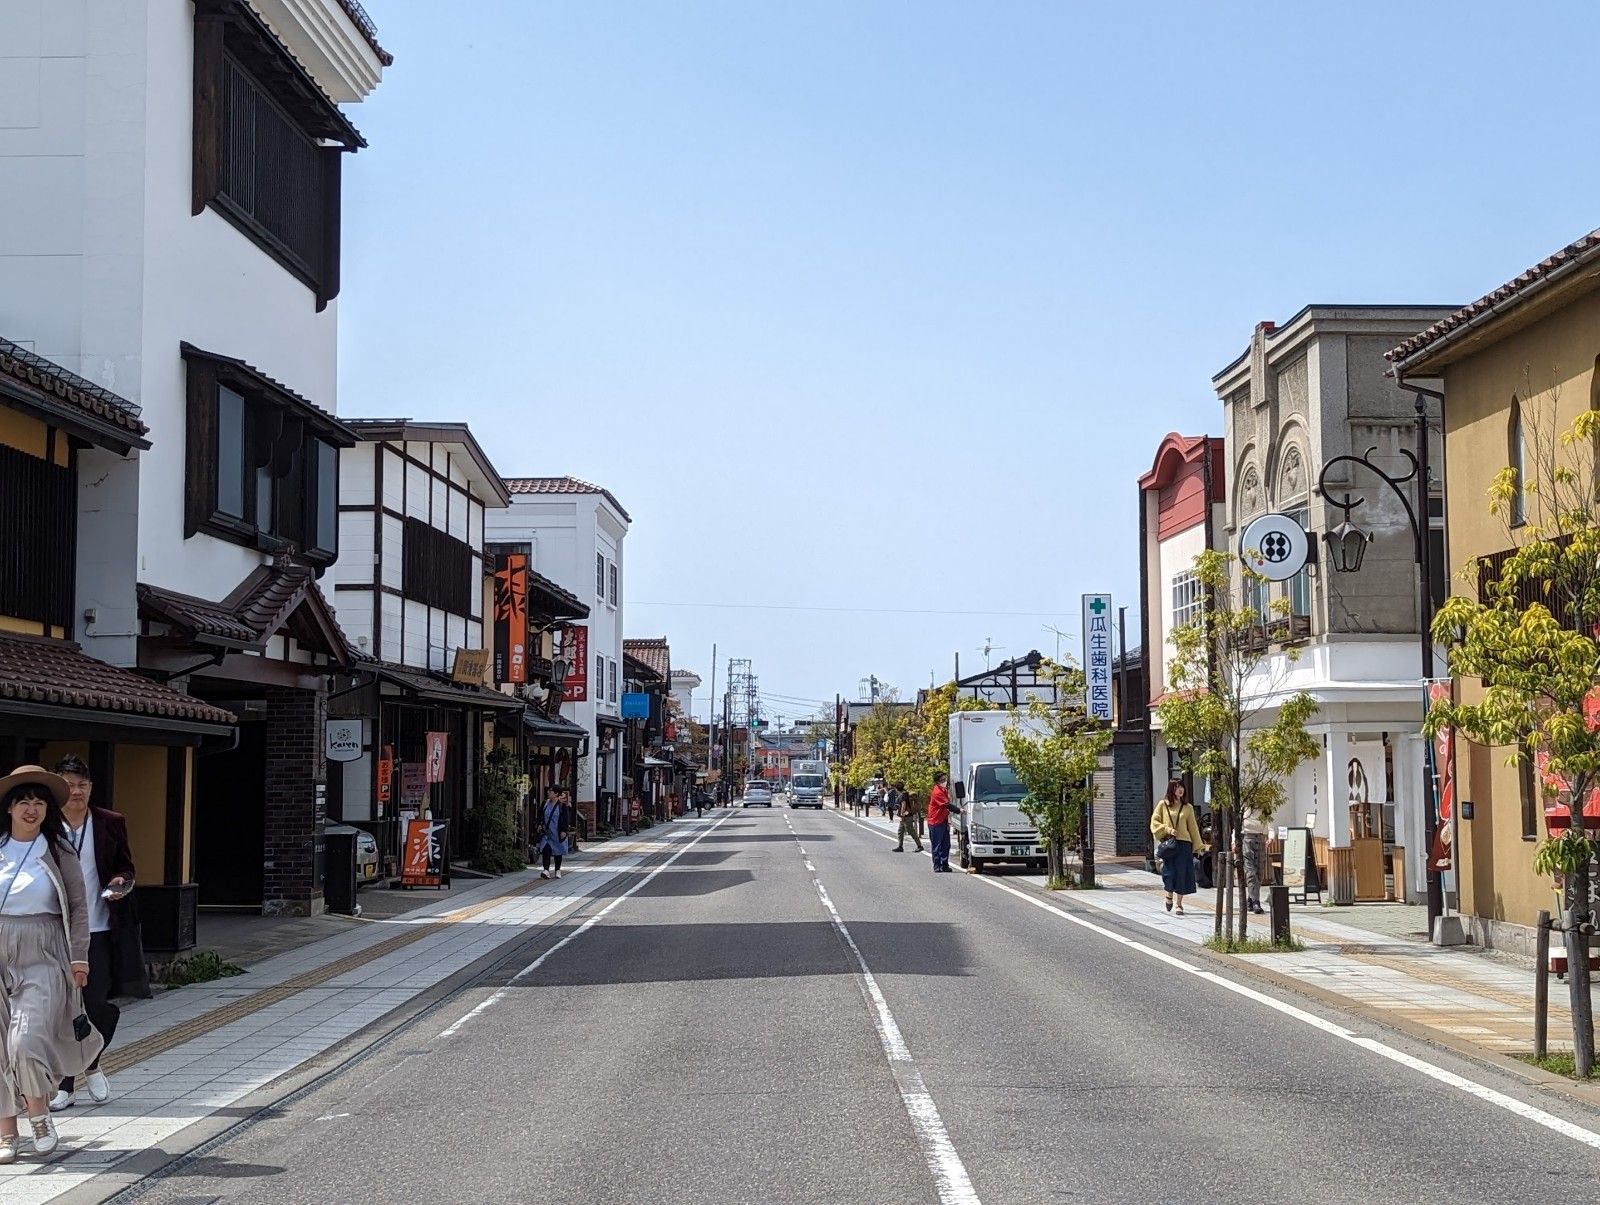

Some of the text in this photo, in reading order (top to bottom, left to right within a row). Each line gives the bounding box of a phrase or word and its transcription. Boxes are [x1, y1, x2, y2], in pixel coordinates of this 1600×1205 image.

[494, 556, 526, 621] 漆
[1090, 616, 1108, 718] 瓜生歯科医院
[573, 686, 584, 697] P
[381, 785, 389, 793] P
[411, 820, 446, 866] 漆
